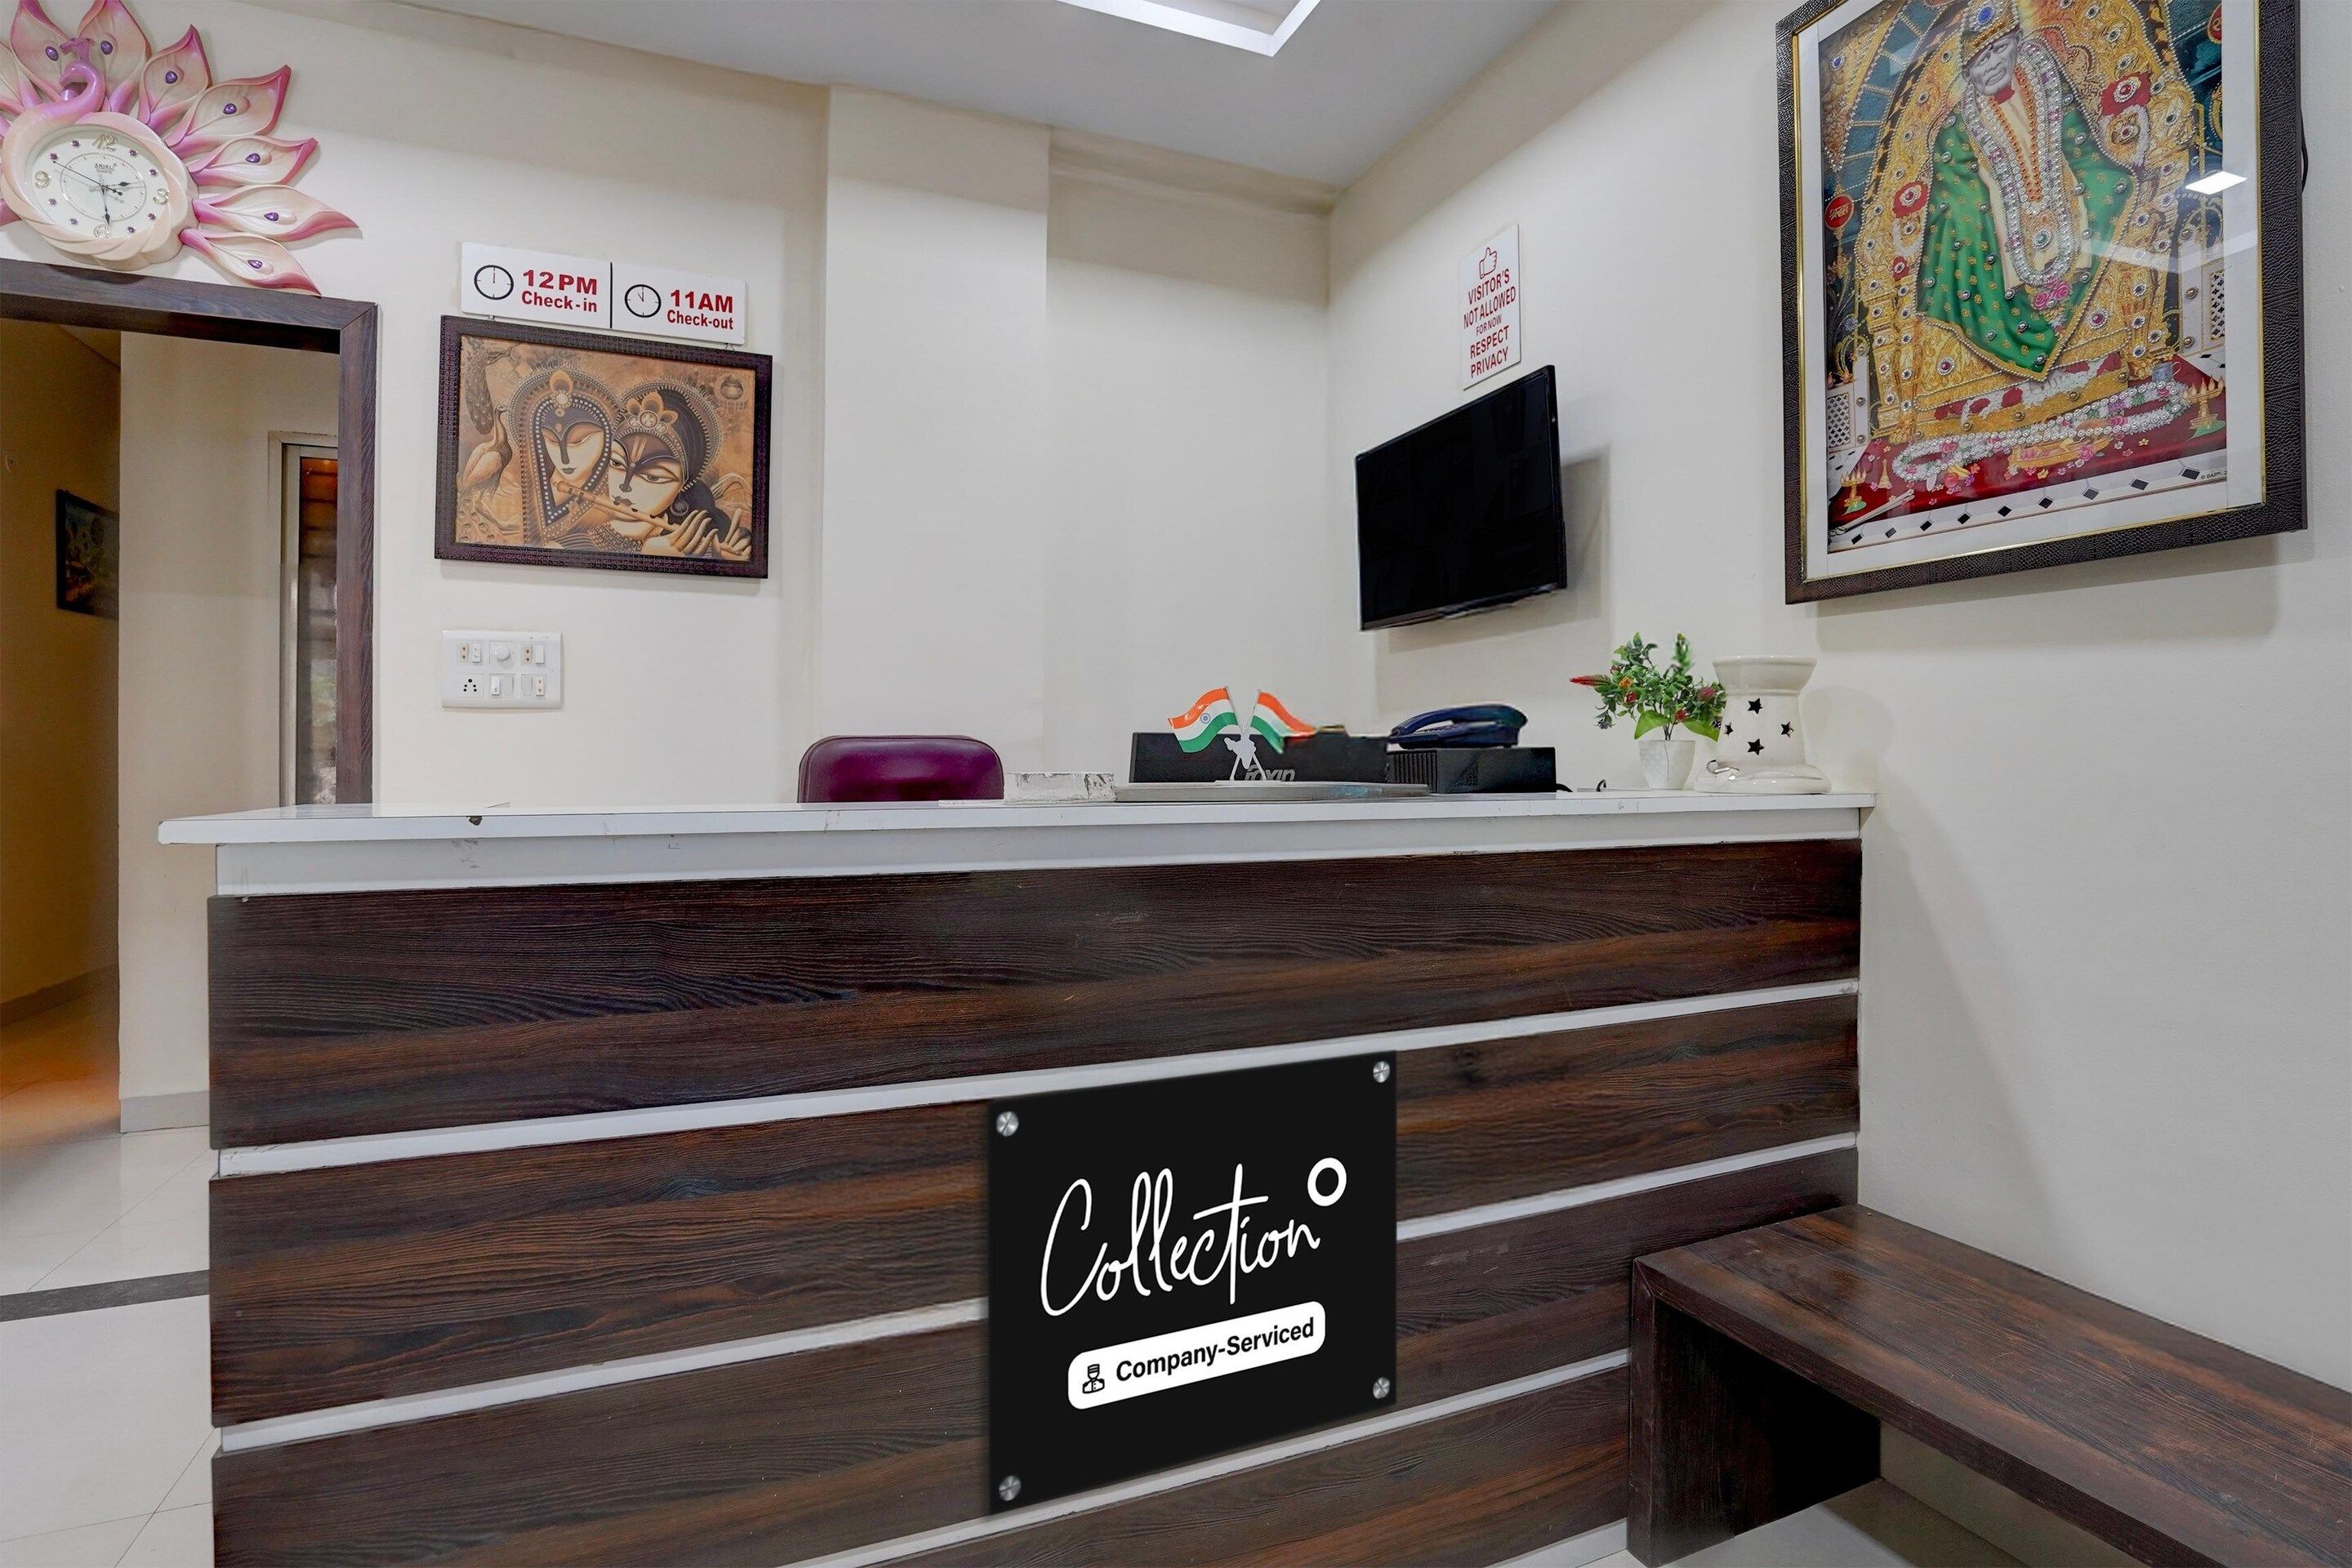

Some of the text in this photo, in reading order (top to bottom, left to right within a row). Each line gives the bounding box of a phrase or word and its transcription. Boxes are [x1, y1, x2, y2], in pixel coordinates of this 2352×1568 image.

[1468, 268, 1510, 305] VISITOR'S
[666, 310, 733, 329] Check-out
[1463, 286, 1517, 329] NOT ALLOWED
[1476, 314, 1503, 336] FOR NOW
[1470, 325, 1509, 359] RESPECT
[1471, 346, 1508, 378] PRIVACY
[1040, 1163, 1321, 1316] Collection
[1116, 1316, 1315, 1382] Company-Serviced
